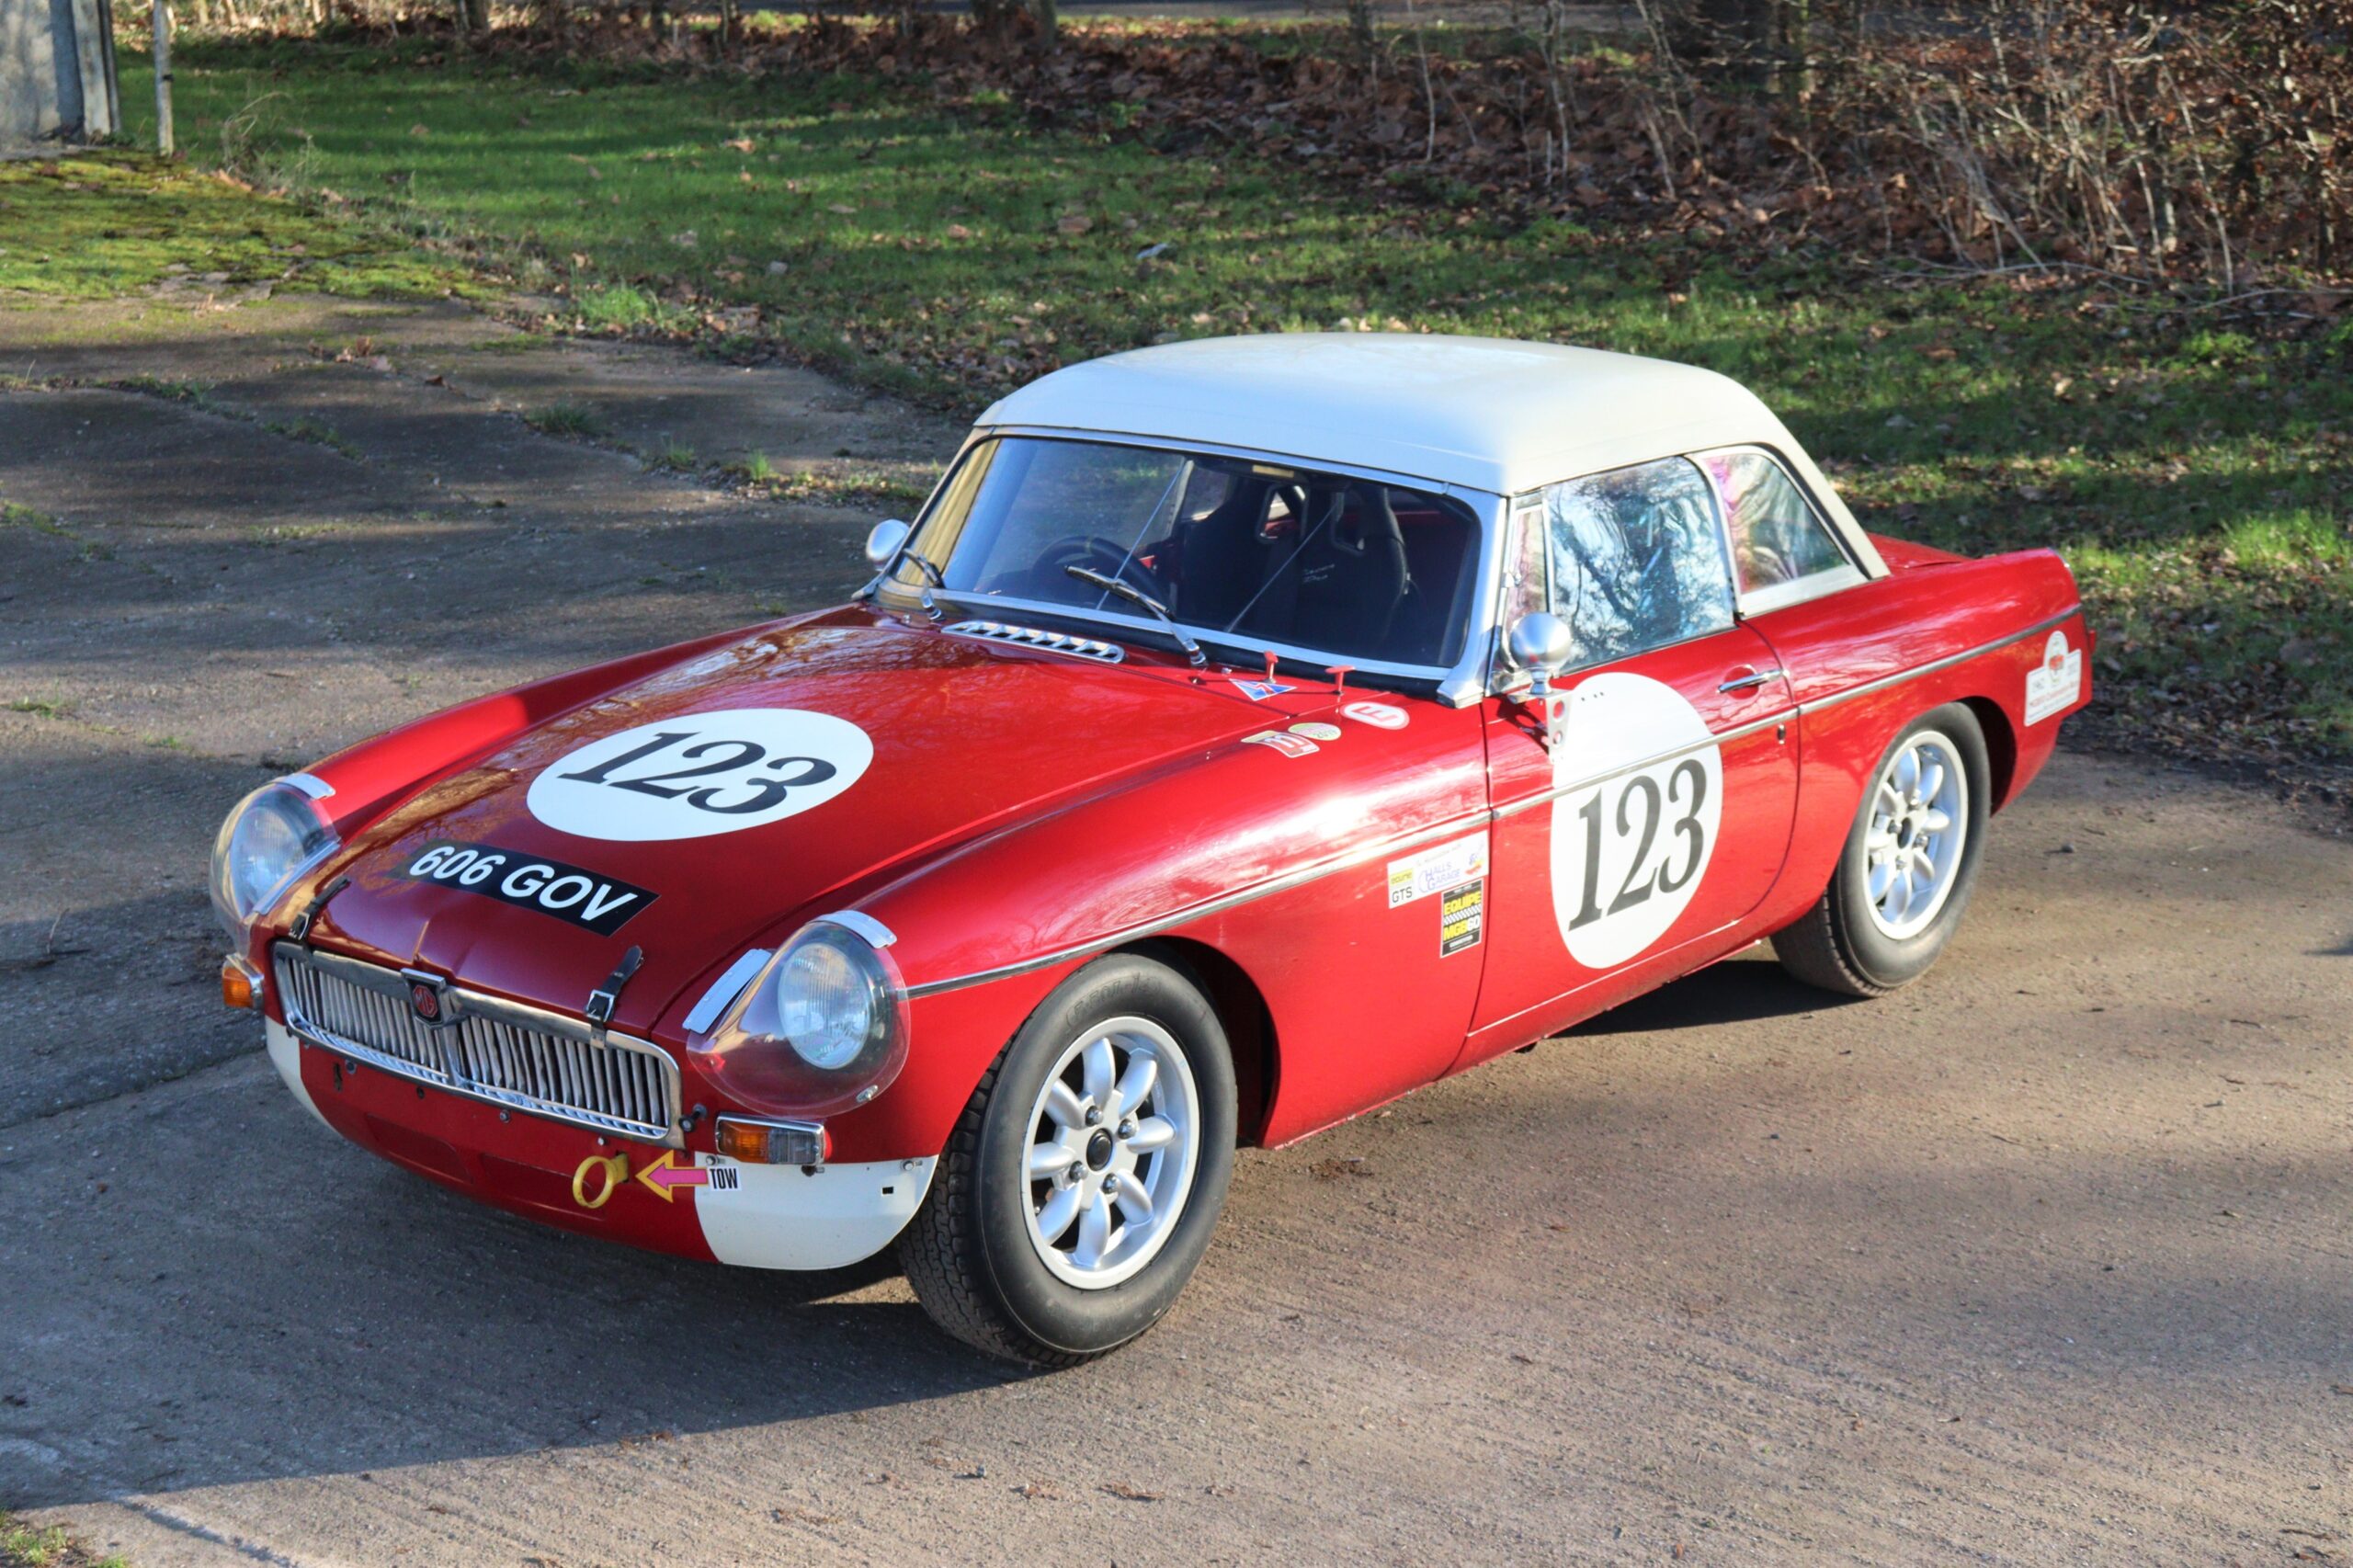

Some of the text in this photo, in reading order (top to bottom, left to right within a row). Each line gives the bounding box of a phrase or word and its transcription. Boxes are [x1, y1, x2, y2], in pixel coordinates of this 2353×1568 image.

[557, 732, 837, 814] 123
[1568, 758, 1708, 932] 123
[409, 846, 638, 921] 606 GOV
[1392, 886, 1413, 903] GTS
[1443, 890, 1482, 915] EQUIPE
[710, 1167, 738, 1189] TOW
